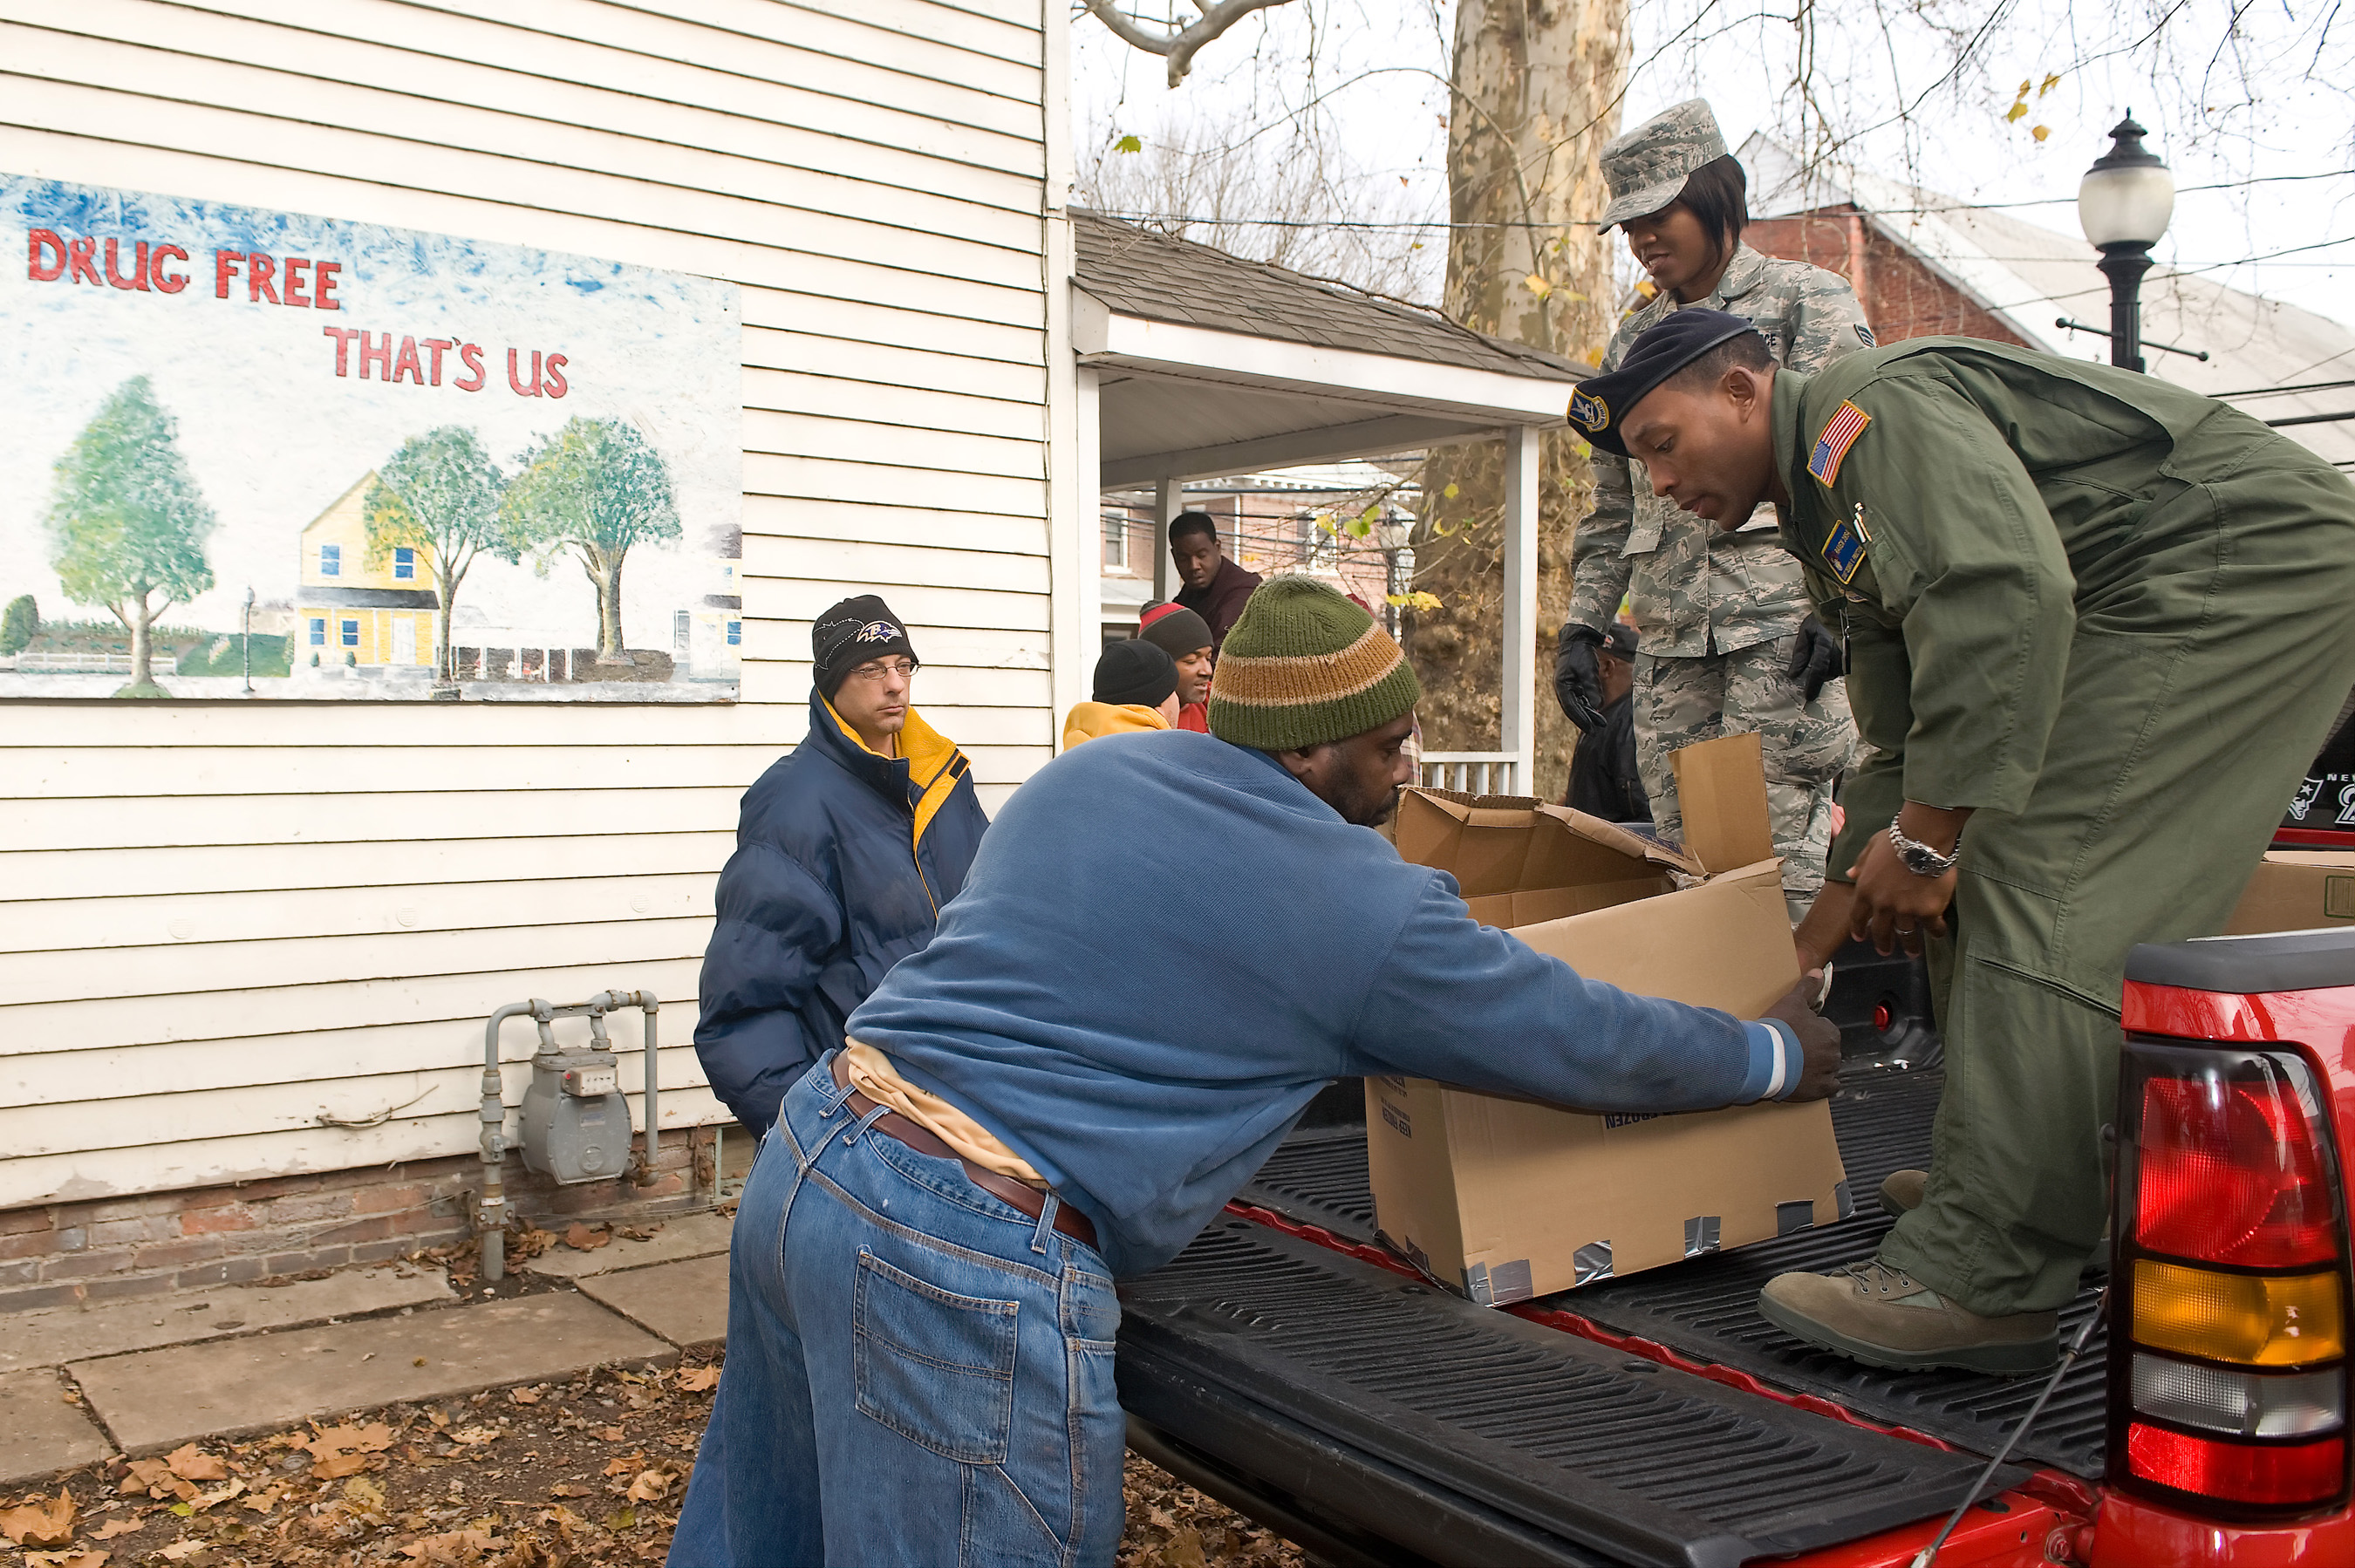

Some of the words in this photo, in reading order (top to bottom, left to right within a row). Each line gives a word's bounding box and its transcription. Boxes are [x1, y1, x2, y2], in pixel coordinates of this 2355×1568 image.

[28, 228, 191, 295] DRUG
[215, 249, 342, 310] FREE
[323, 325, 487, 392] THAT'S
[507, 347, 569, 399] US
[2326, 773, 2355, 782] NE
